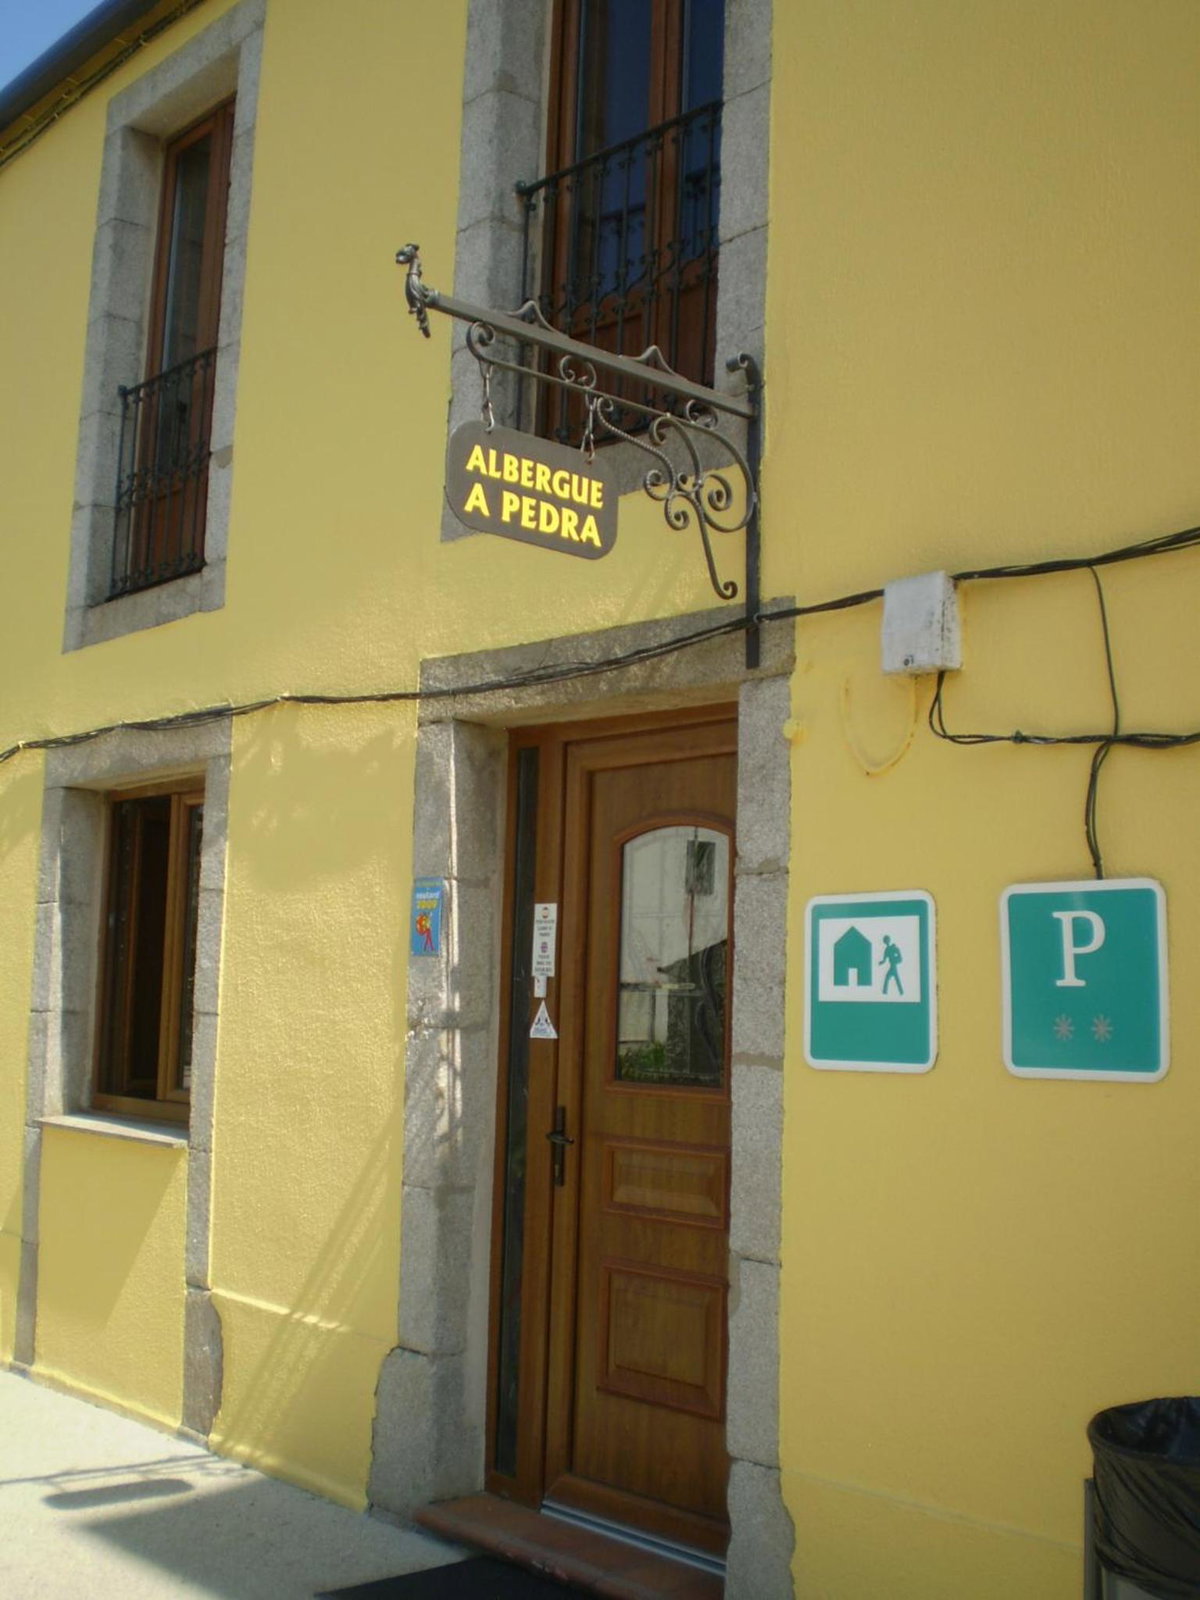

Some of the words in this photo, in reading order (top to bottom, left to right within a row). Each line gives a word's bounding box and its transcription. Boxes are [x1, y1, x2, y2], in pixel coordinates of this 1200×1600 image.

[465, 444, 604, 509] ALBERGUE
[463, 482, 490, 517] A
[501, 490, 602, 547] PEDRA
[1051, 910, 1106, 987] P
